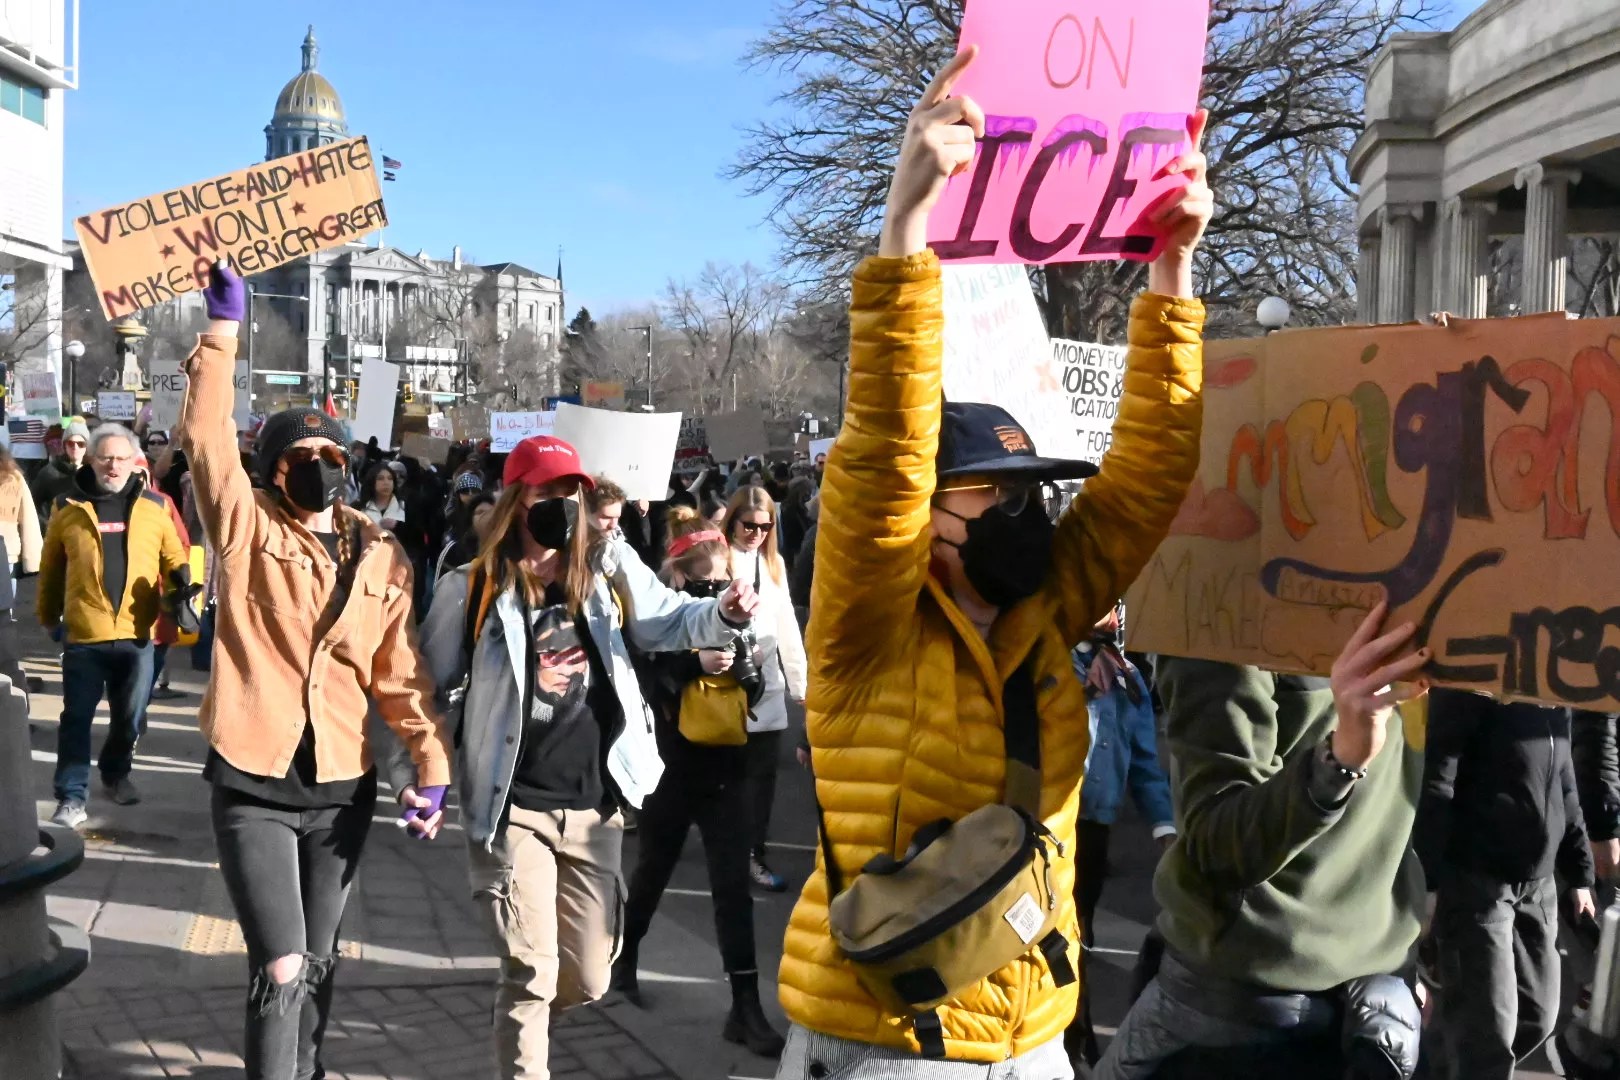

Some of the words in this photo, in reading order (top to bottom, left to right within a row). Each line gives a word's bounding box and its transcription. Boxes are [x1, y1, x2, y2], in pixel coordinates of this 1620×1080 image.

[1044, 13, 1134, 90] ON
[78, 176, 239, 244] VIOLENCE
[246, 165, 292, 201] AND
[296, 139, 370, 188] HATE
[926, 114, 1187, 261] ICE
[103, 265, 193, 318] MAKE
[1054, 342, 1106, 367] MONEY
[1108, 350, 1124, 370] FO
[1126, 549, 1263, 652] MAKE
